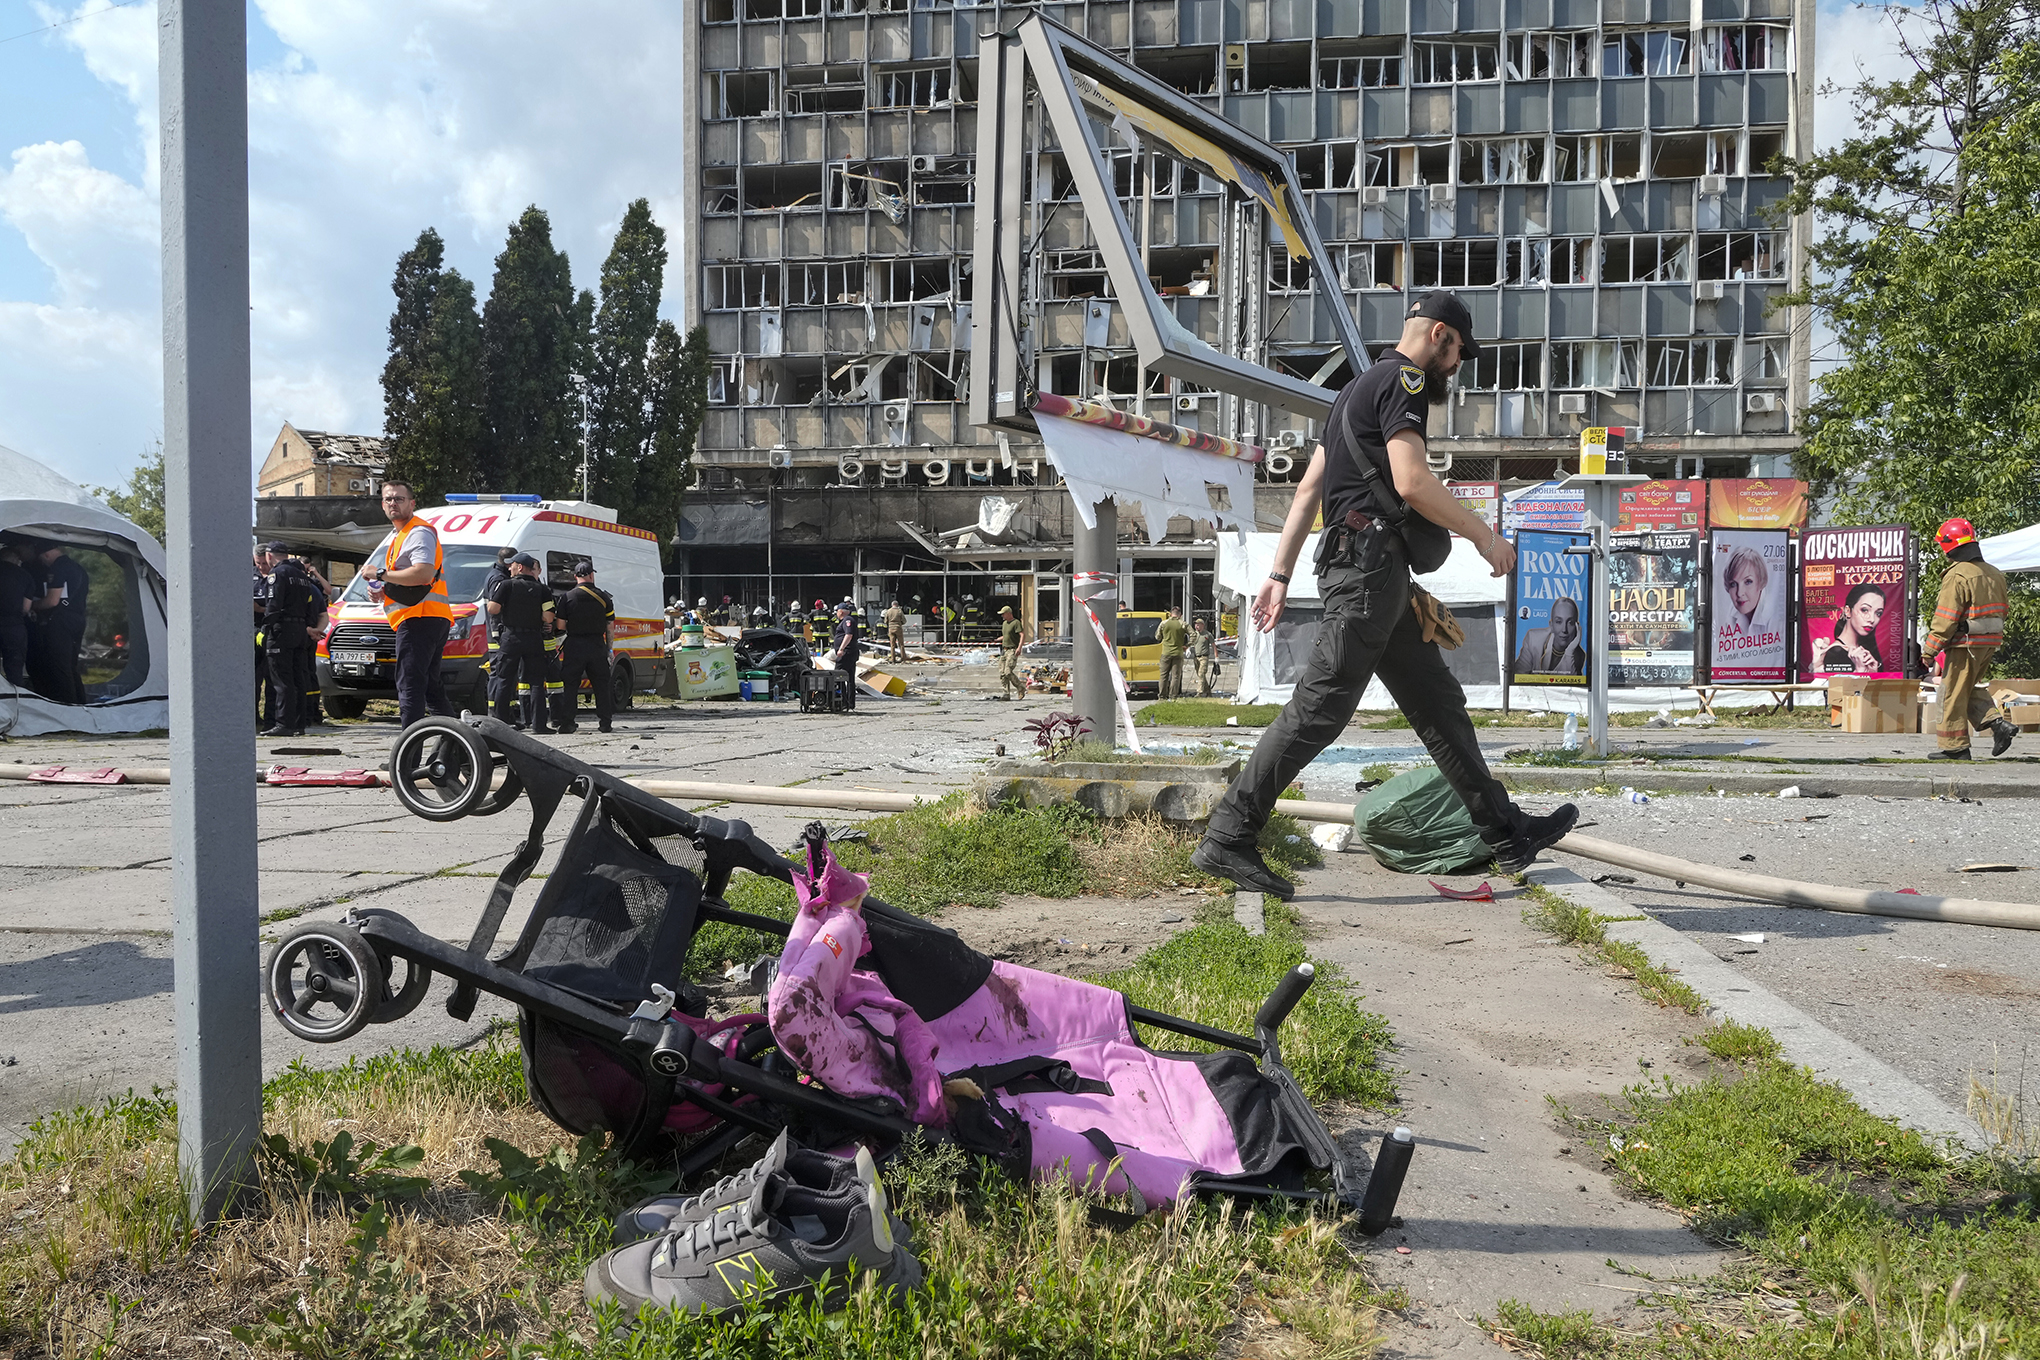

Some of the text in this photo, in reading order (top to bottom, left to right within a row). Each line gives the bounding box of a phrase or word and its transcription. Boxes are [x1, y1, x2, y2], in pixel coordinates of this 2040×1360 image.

[837, 452, 1039, 485] будин
[1516, 502, 1585, 512] ВІДЕОНАГЛЯД
[1763, 545, 1785, 557] 27.06
[1805, 530, 1904, 560] ЛУСКУНЧИК
[1522, 550, 1585, 576] ROXO
[1842, 564, 1904, 573] КАТЕРИНОЮ
[1844, 572, 1903, 585] КУХАР
[1523, 576, 1583, 601] LANA
[1806, 589, 1829, 597] БАЛЕТ
[1610, 588, 1686, 611] НАОНІ
[1609, 611, 1685, 622] ОРКЕСТРА
[1719, 623, 1742, 639] АДА
[1719, 632, 1781, 653] РОГОВЦЕВА
[1741, 649, 1758, 658] КОГО
